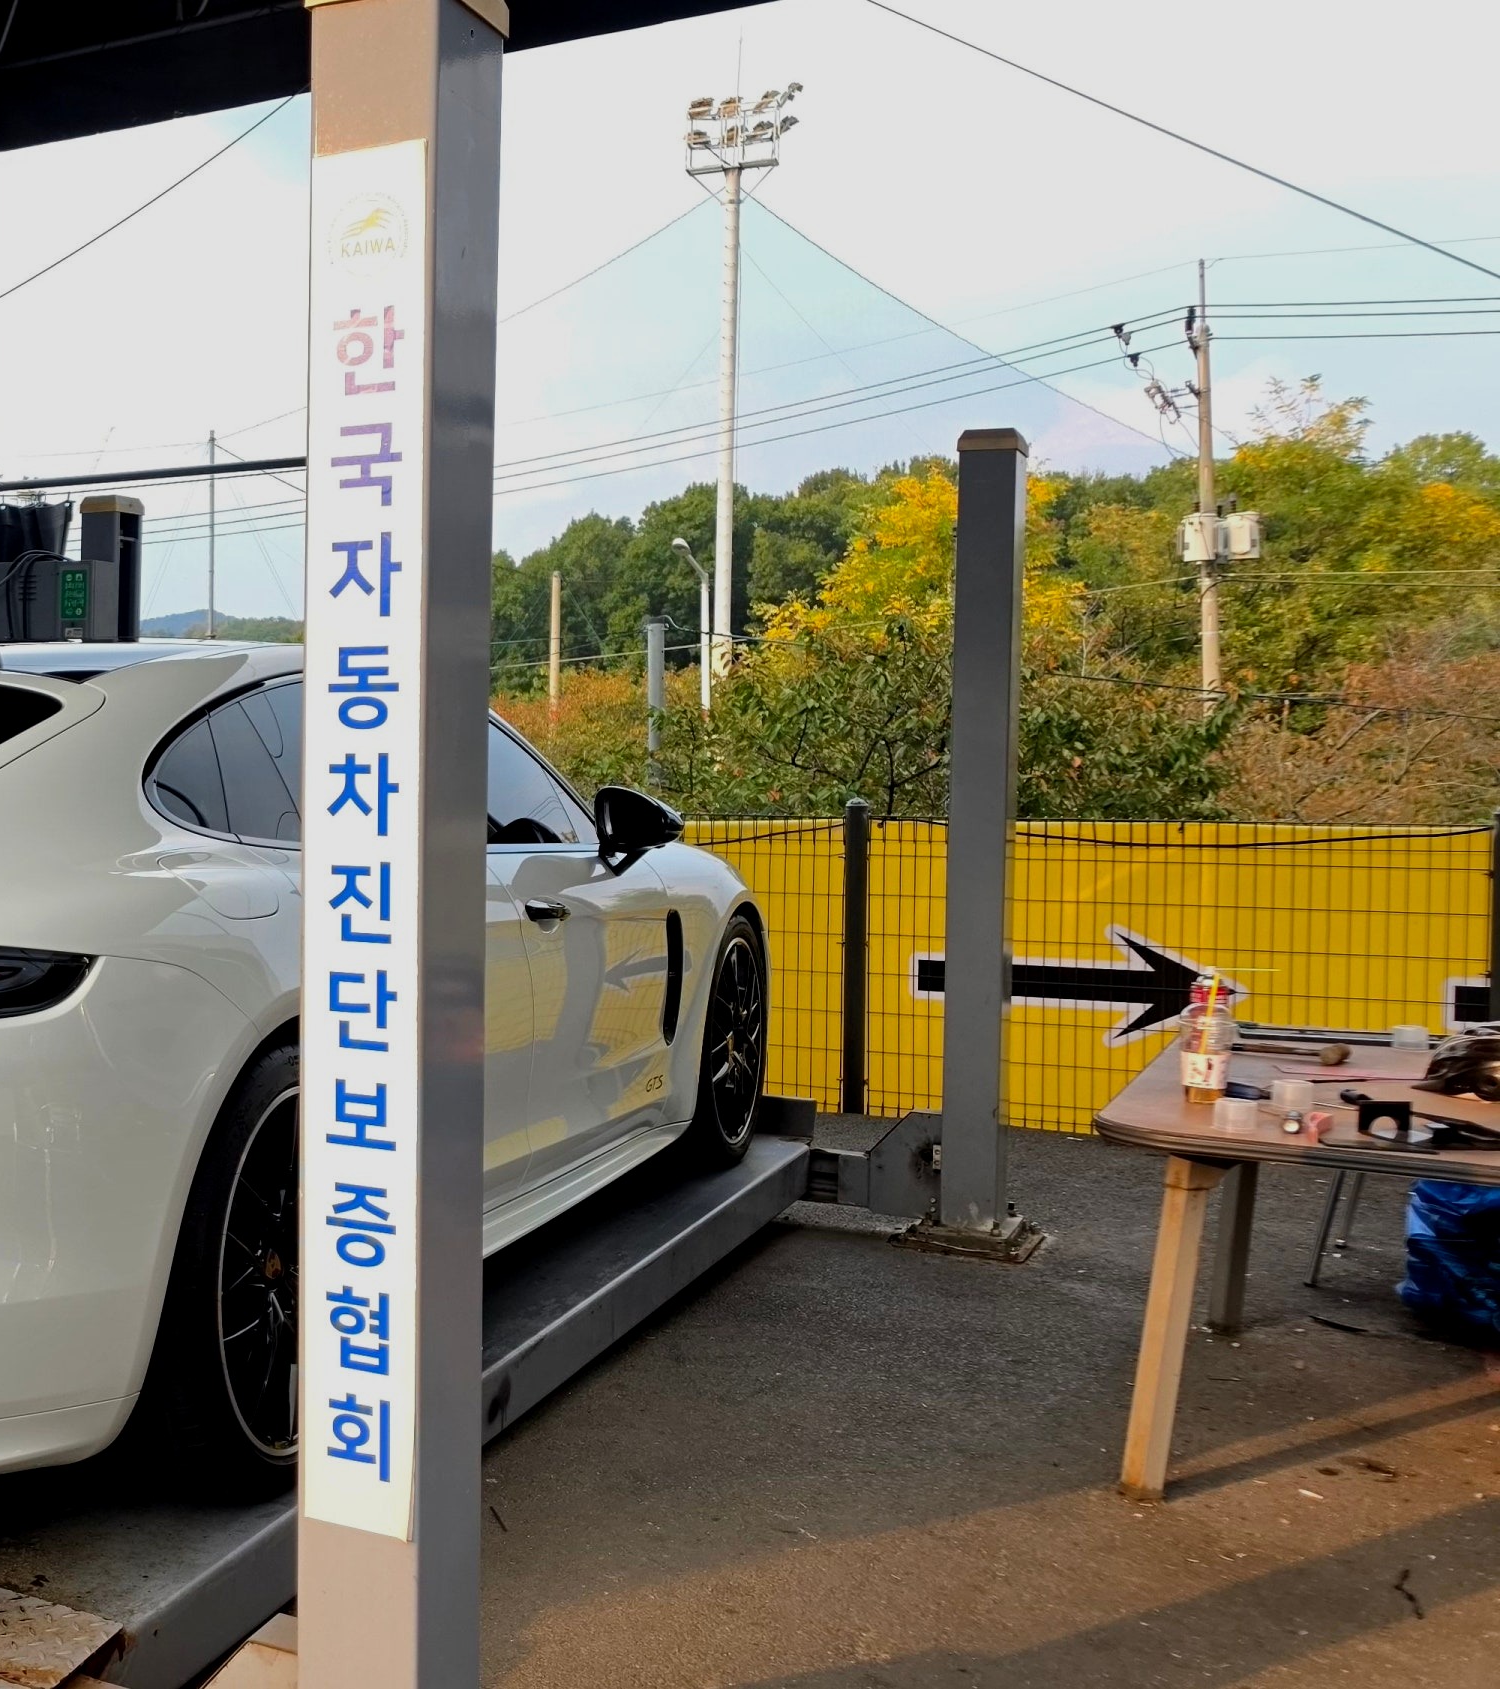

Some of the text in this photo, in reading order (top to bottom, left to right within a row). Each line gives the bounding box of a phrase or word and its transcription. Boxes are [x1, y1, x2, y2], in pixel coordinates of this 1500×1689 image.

[341, 237, 395, 258] KAIWA
[326, 304, 405, 1483] 한국자동차진단보증협회
[646, 1074, 663, 1092] GTS
